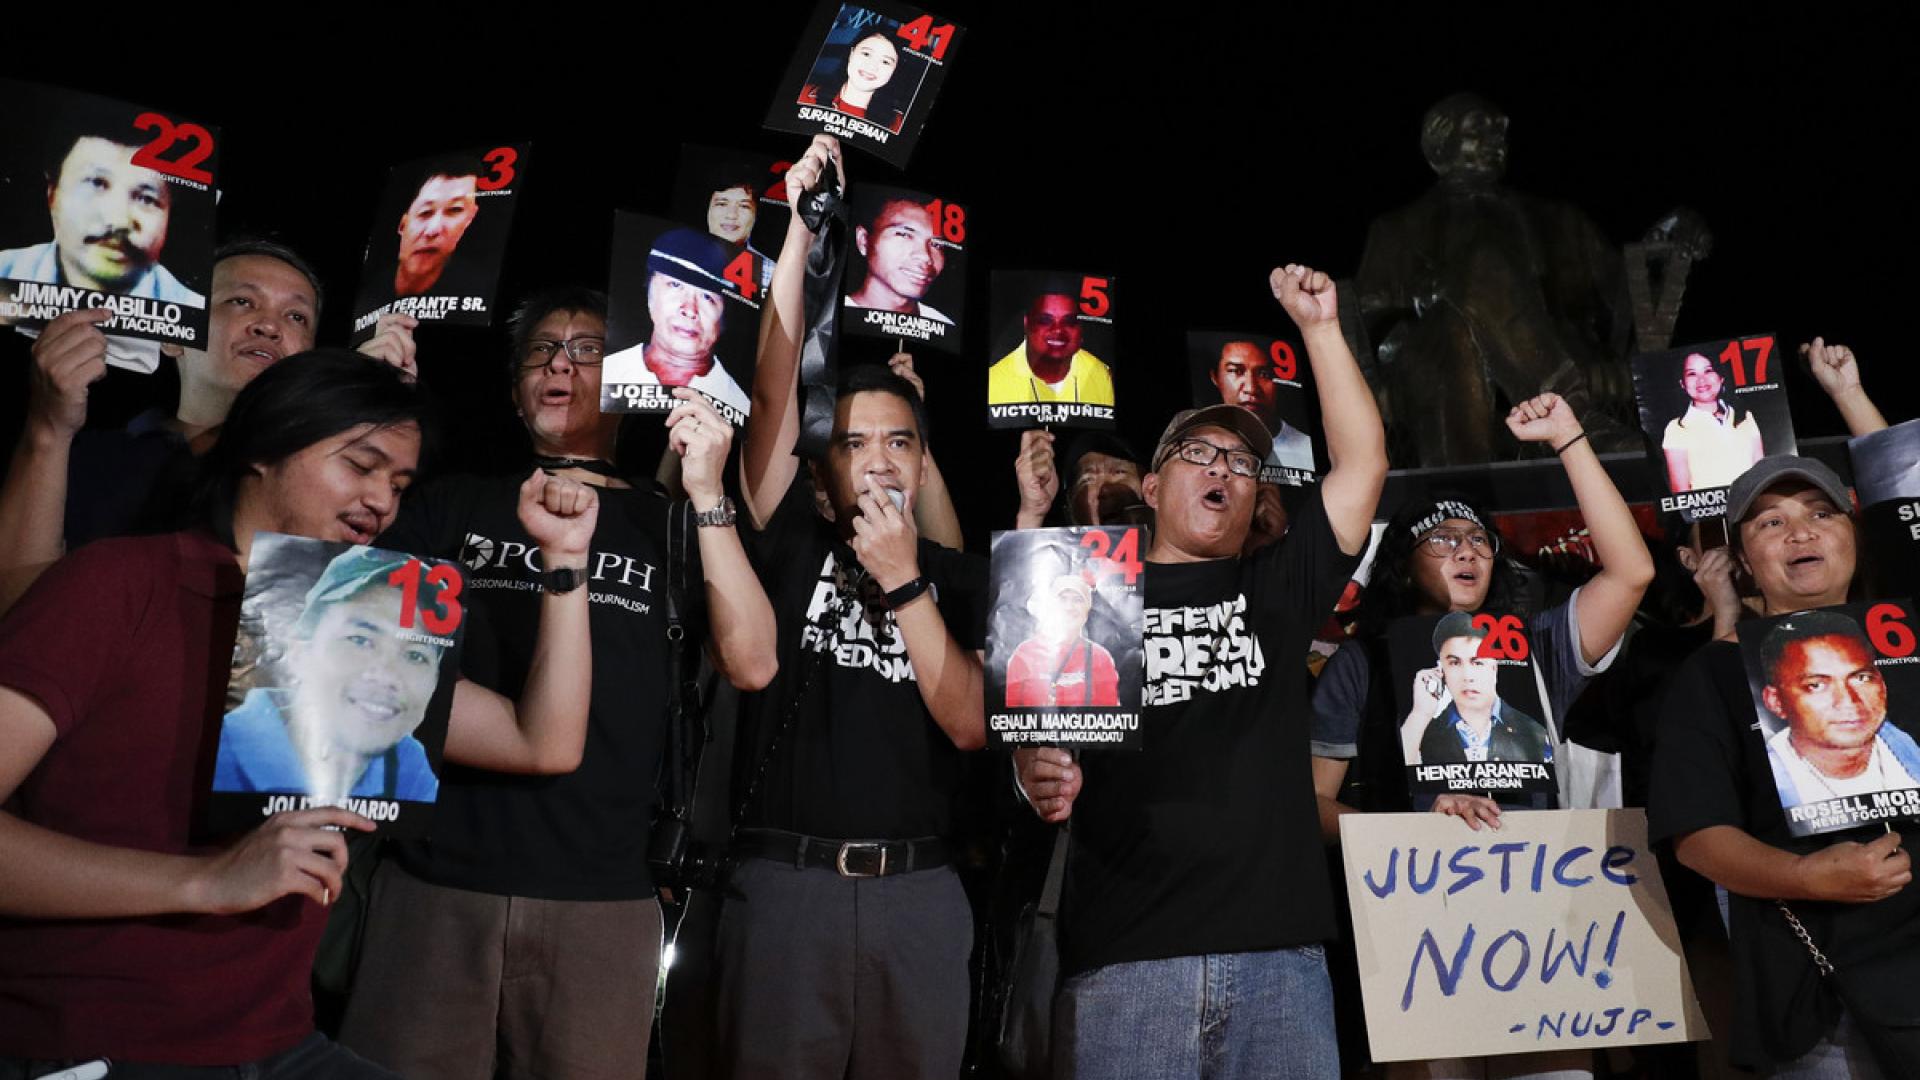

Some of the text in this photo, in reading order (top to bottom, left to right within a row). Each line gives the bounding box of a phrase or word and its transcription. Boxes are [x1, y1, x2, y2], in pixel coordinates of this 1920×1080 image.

[896, 14, 957, 60] 41
[798, 107, 889, 144] SURAIDA BEMAN
[130, 111, 214, 186] 22
[476, 147, 518, 191] 3
[926, 199, 965, 243] 18
[723, 251, 757, 300] 4
[11, 282, 86, 309] JIMMY
[87, 292, 182, 324] CABILLO
[391, 297, 458, 315] PERANTE
[461, 297, 487, 312] SR.
[417, 310, 449, 320] DAILY
[1079, 276, 1110, 317] 5
[120, 316, 196, 341] TACURONG
[864, 310, 897, 325] JOHN
[1270, 340, 1297, 381] 9
[1719, 336, 1774, 387] 17
[610, 384, 669, 399] JOEL
[991, 403, 1114, 419] VICTOR NUÑEZ
[1660, 489, 1727, 512] ELEANOR
[387, 558, 464, 635] 13
[1471, 613, 1529, 661] 26
[1865, 603, 1916, 659] 6
[990, 713, 1139, 730] GENALIN MANGUDADATU
[1001, 732, 1020, 742] WIFE
[1020, 732, 1030, 741] OF
[1060, 731, 1124, 743] MANGUDADATU
[1416, 763, 1549, 781] HENRY ARANETA
[1448, 778, 1523, 789] DZRH GENSAN
[1790, 796, 1868, 823] ROSELL
[1812, 815, 1849, 830] NEWS
[1852, 806, 1898, 822] FOCUS
[1400, 910, 1626, 1012] NOW!
